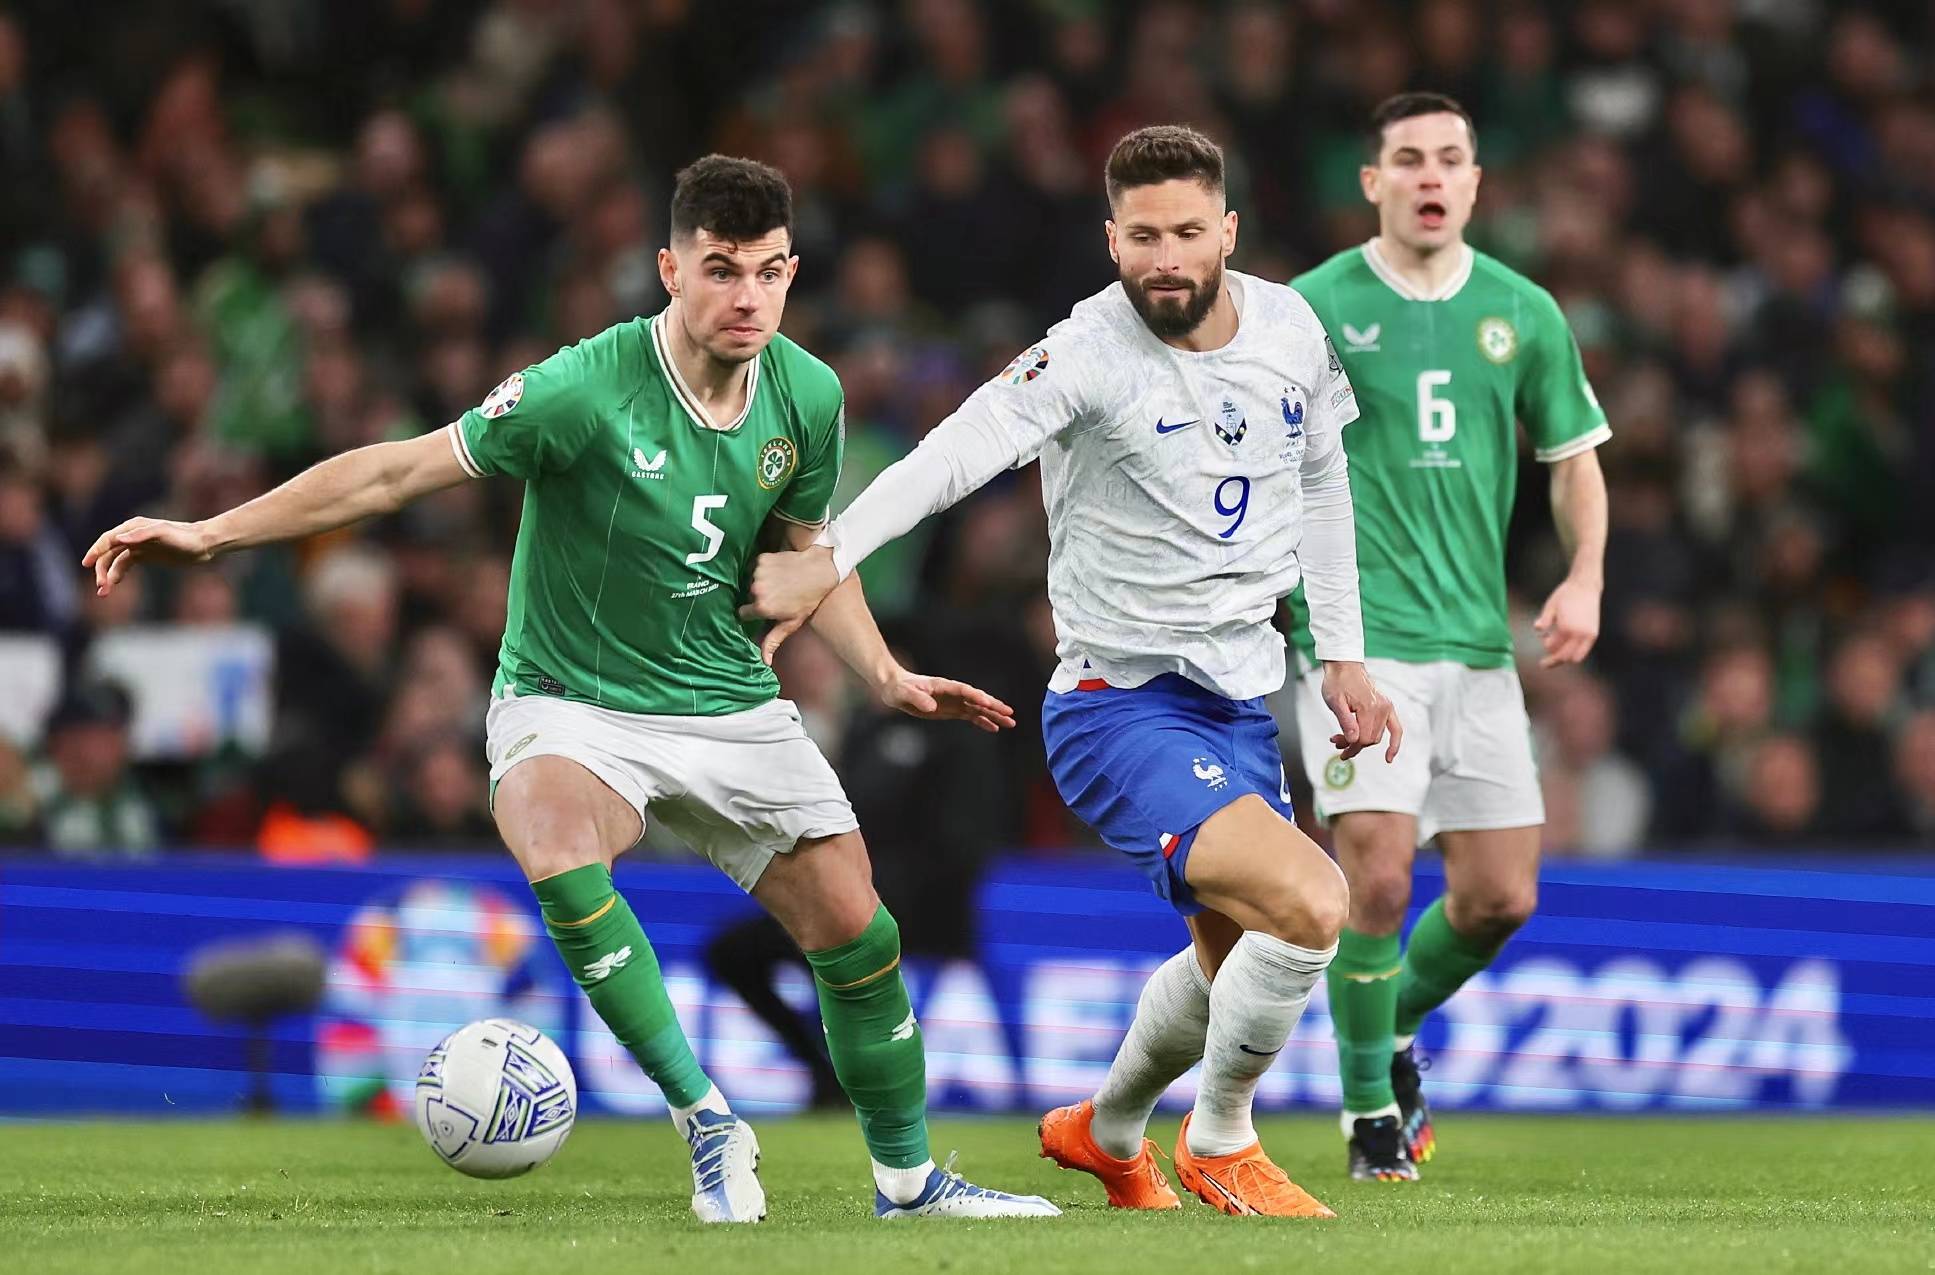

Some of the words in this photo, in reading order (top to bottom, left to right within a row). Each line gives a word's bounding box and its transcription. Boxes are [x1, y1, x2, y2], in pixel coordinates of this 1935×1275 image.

[1417, 370, 1456, 442] 6
[685, 494, 729, 566] 5
[1214, 475, 1251, 539] 9
[577, 960, 1020, 1113] UEA
